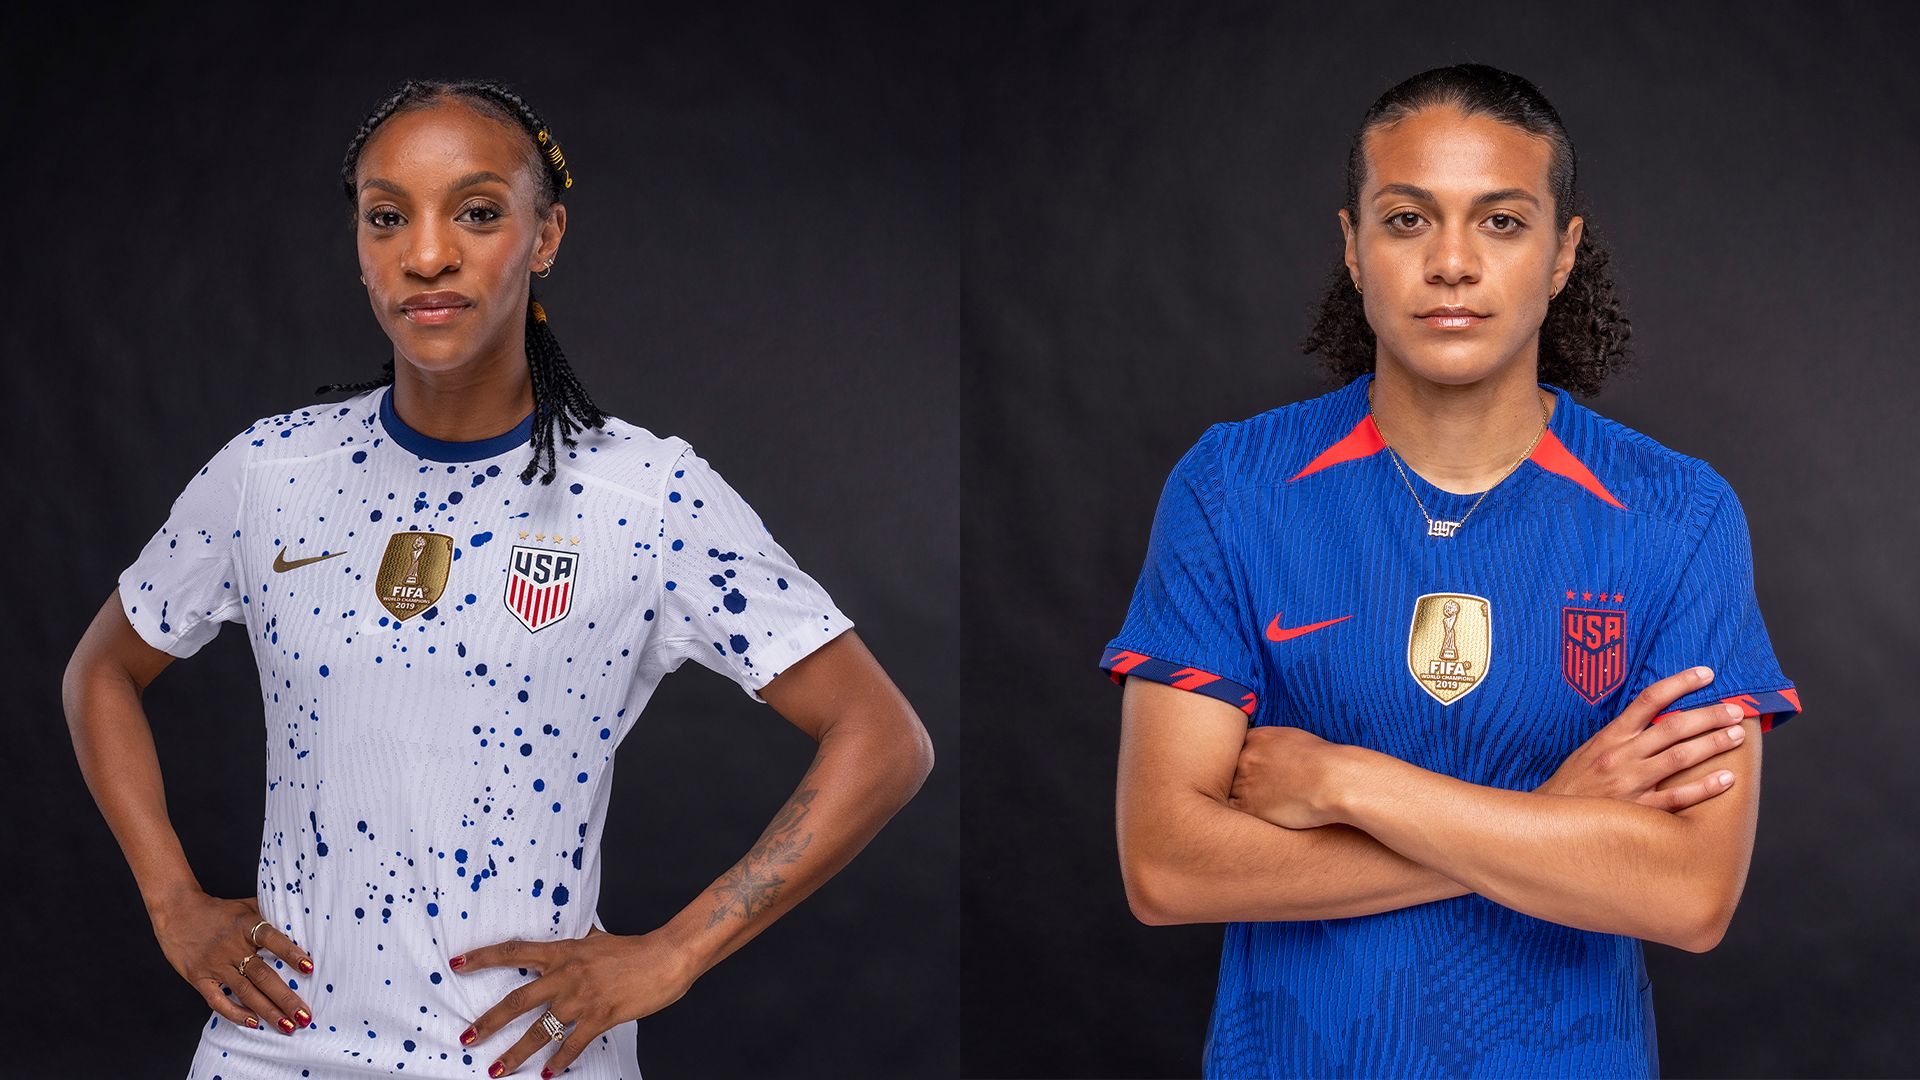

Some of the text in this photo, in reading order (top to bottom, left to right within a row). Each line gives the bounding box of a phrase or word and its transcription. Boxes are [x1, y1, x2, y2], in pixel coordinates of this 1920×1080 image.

[1428, 519, 1459, 537] 1997
[515, 551, 573, 584] USA
[1568, 613, 1621, 649] USA
[1436, 680, 1458, 689] 2019
